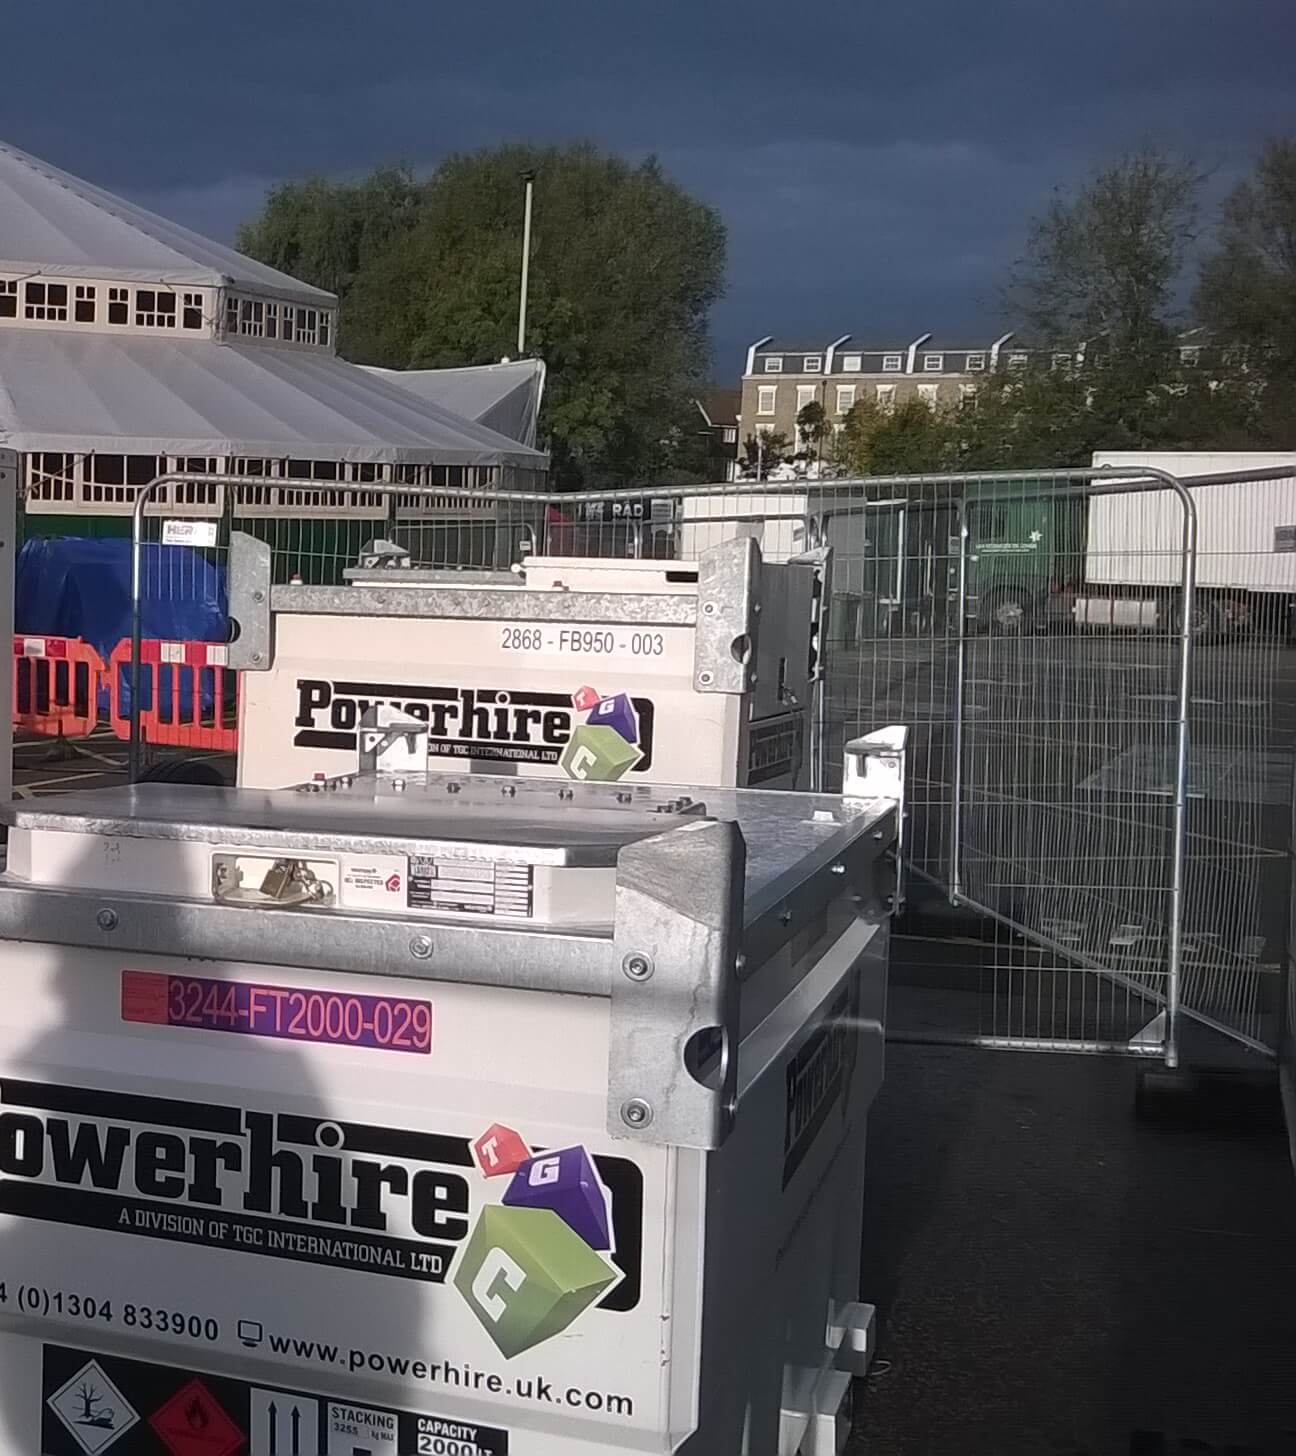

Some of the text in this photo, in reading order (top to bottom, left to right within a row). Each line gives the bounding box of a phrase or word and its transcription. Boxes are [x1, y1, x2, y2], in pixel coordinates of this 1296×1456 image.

[501, 628, 542, 650] 2868
[559, 630, 614, 653] FB950
[631, 633, 664, 655] 003
[470, 746, 540, 760] INTERNATIONAL
[541, 750, 558, 761] LTD
[168, 980, 431, 1048] 3244-FT2000-029
[118, 1208, 443, 1274] A DIVISION OF TGC INTERNATIONAL LTD
[17, 1285, 113, 1322] (0)1304
[123, 1304, 219, 1341] 833900
[269, 1334, 634, 1416] www.powerhire.uk.com
[331, 1406, 394, 1429] STACKING
[417, 1418, 477, 1441] CAPACITY
[419, 1435, 474, 1456] 2000
